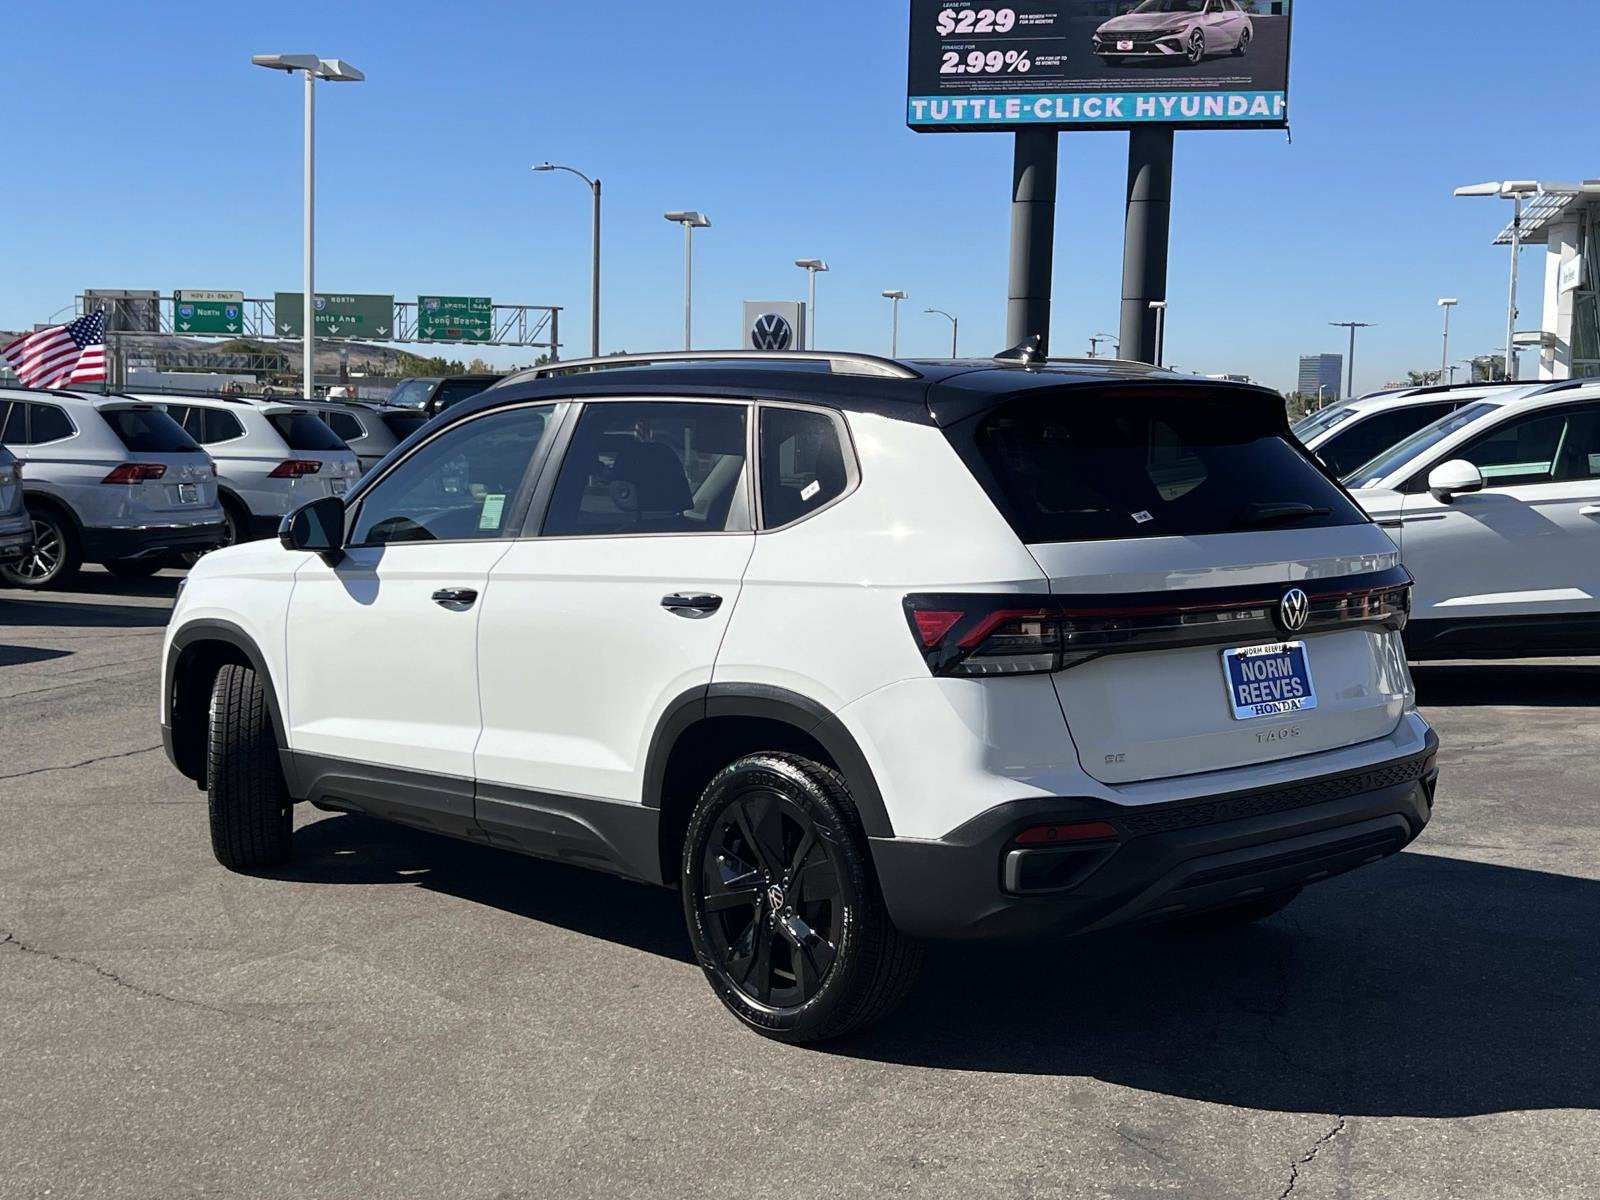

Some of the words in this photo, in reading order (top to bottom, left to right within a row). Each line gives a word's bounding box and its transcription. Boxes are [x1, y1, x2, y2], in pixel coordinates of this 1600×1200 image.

[936, 8, 1016, 36] $229
[939, 50, 1031, 73] 2.99%
[911, 97, 1124, 121] TUTTLE-CLICK
[1135, 95, 1281, 117] HYUNDAI
[315, 314, 335, 323] anta
[338, 315, 356, 323] Ana
[428, 316, 450, 326] Long
[1264, 643, 1287, 653] REEVE
[1240, 657, 1293, 681] NORM
[1238, 677, 1303, 704] REEVES
[1255, 726, 1301, 743] TAOS
[1104, 753, 1126, 763] SE
